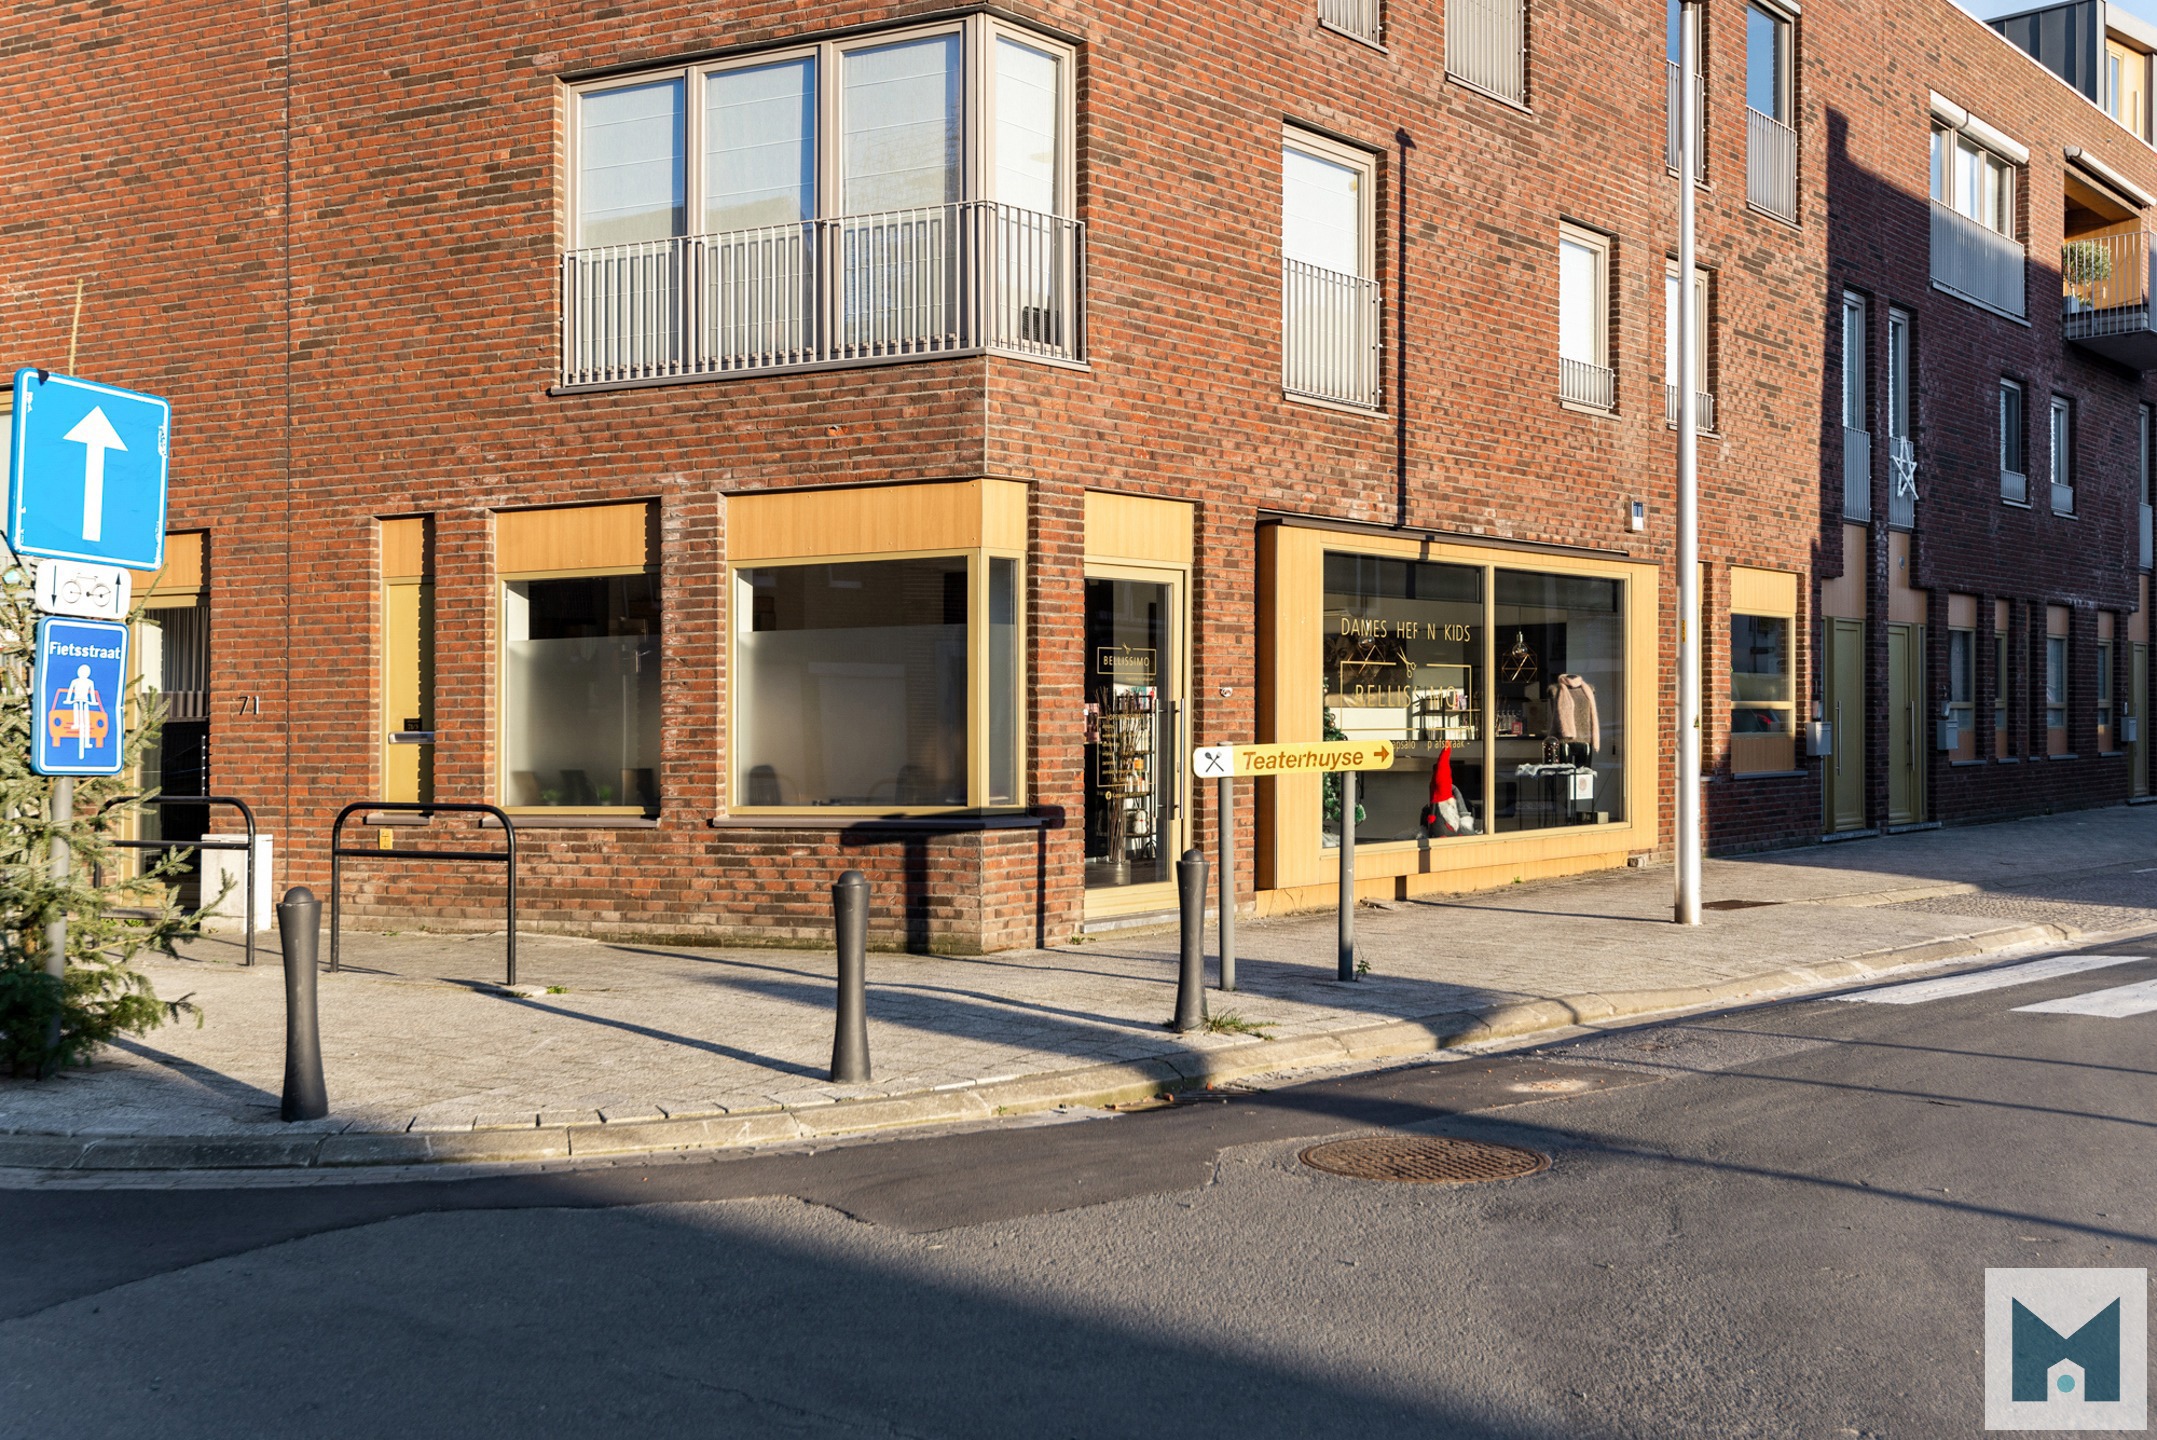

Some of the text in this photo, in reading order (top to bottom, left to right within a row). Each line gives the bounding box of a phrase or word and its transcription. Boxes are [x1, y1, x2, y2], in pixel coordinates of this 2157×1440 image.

[1341, 617, 1387, 638] DAMES
[1444, 623, 1471, 642] KIDS
[50, 641, 121, 660] Fietsstraat
[1103, 655, 1150, 666] BELLISSIMO
[238, 695, 259, 715] 71
[1242, 751, 1364, 771] Teaterhuyse
